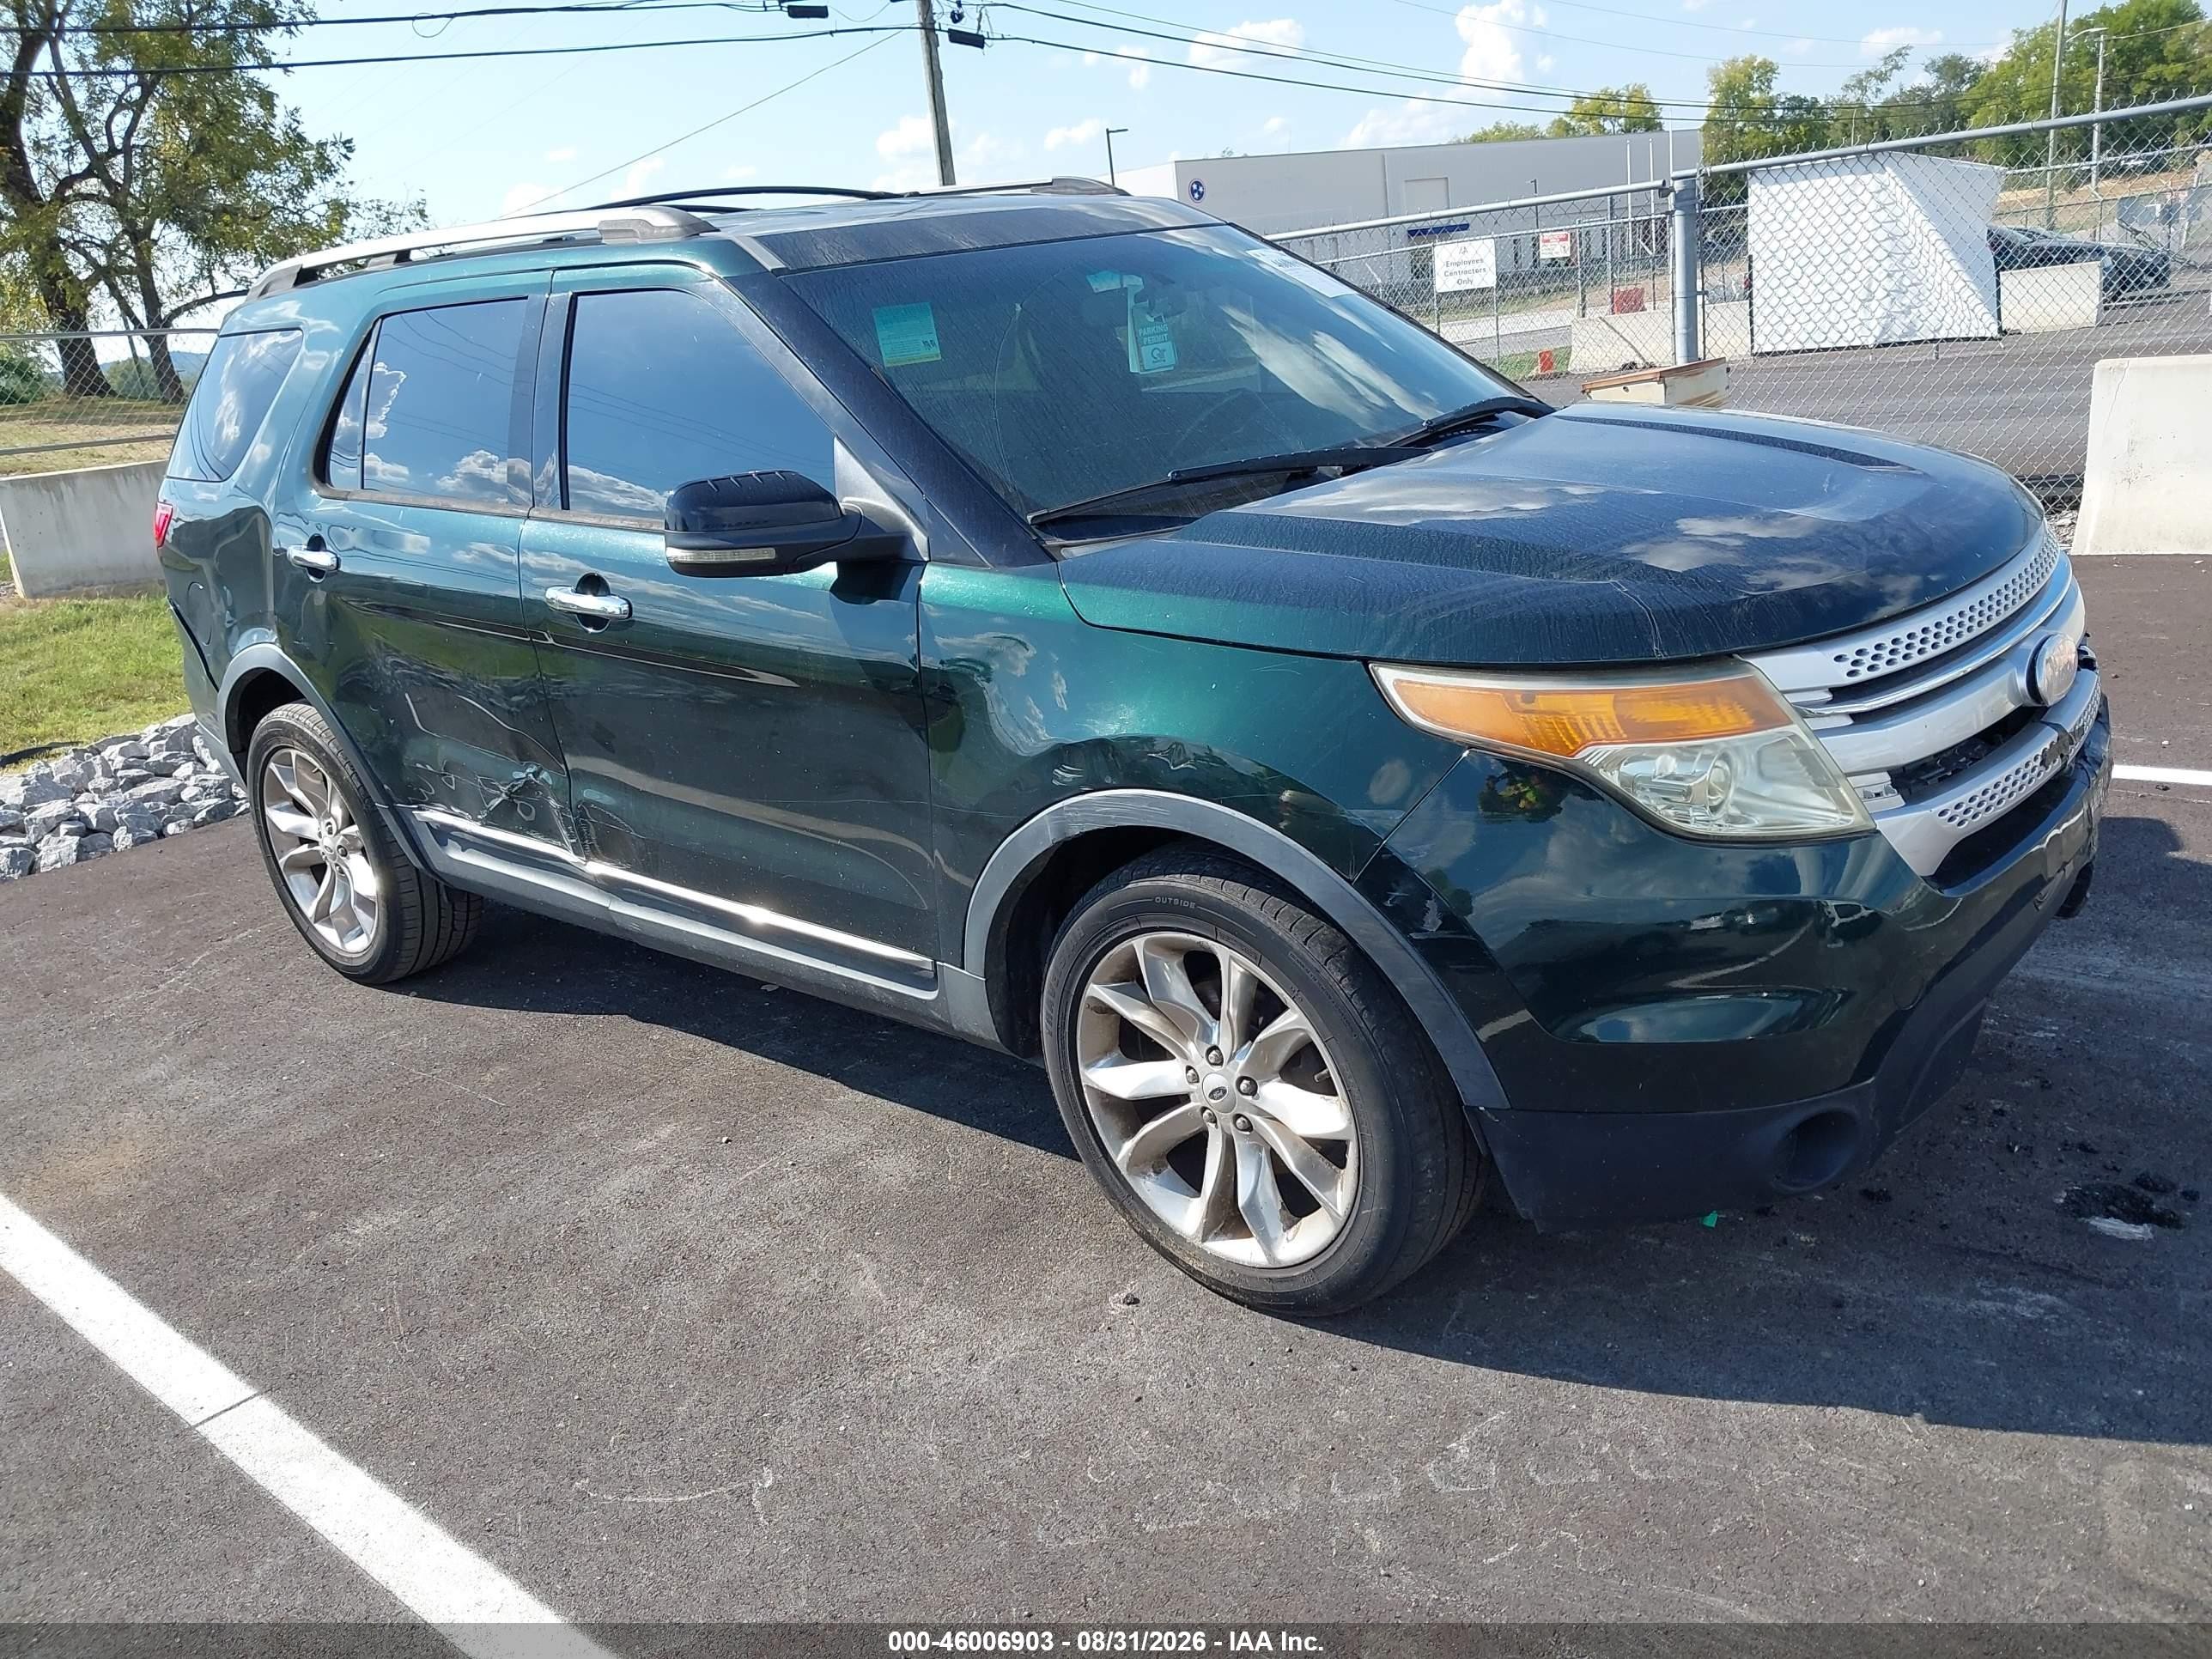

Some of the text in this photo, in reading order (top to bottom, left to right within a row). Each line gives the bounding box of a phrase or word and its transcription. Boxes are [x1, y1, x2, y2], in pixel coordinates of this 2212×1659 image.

[1445, 258, 1484, 268] Employees
[1443, 267, 1486, 277] Contractors
[1456, 277, 1474, 286] Only
[1139, 324, 1169, 337] PARKING
[1143, 334, 1169, 345] PERMIT
[1155, 896, 1196, 908] OUTSIDE
